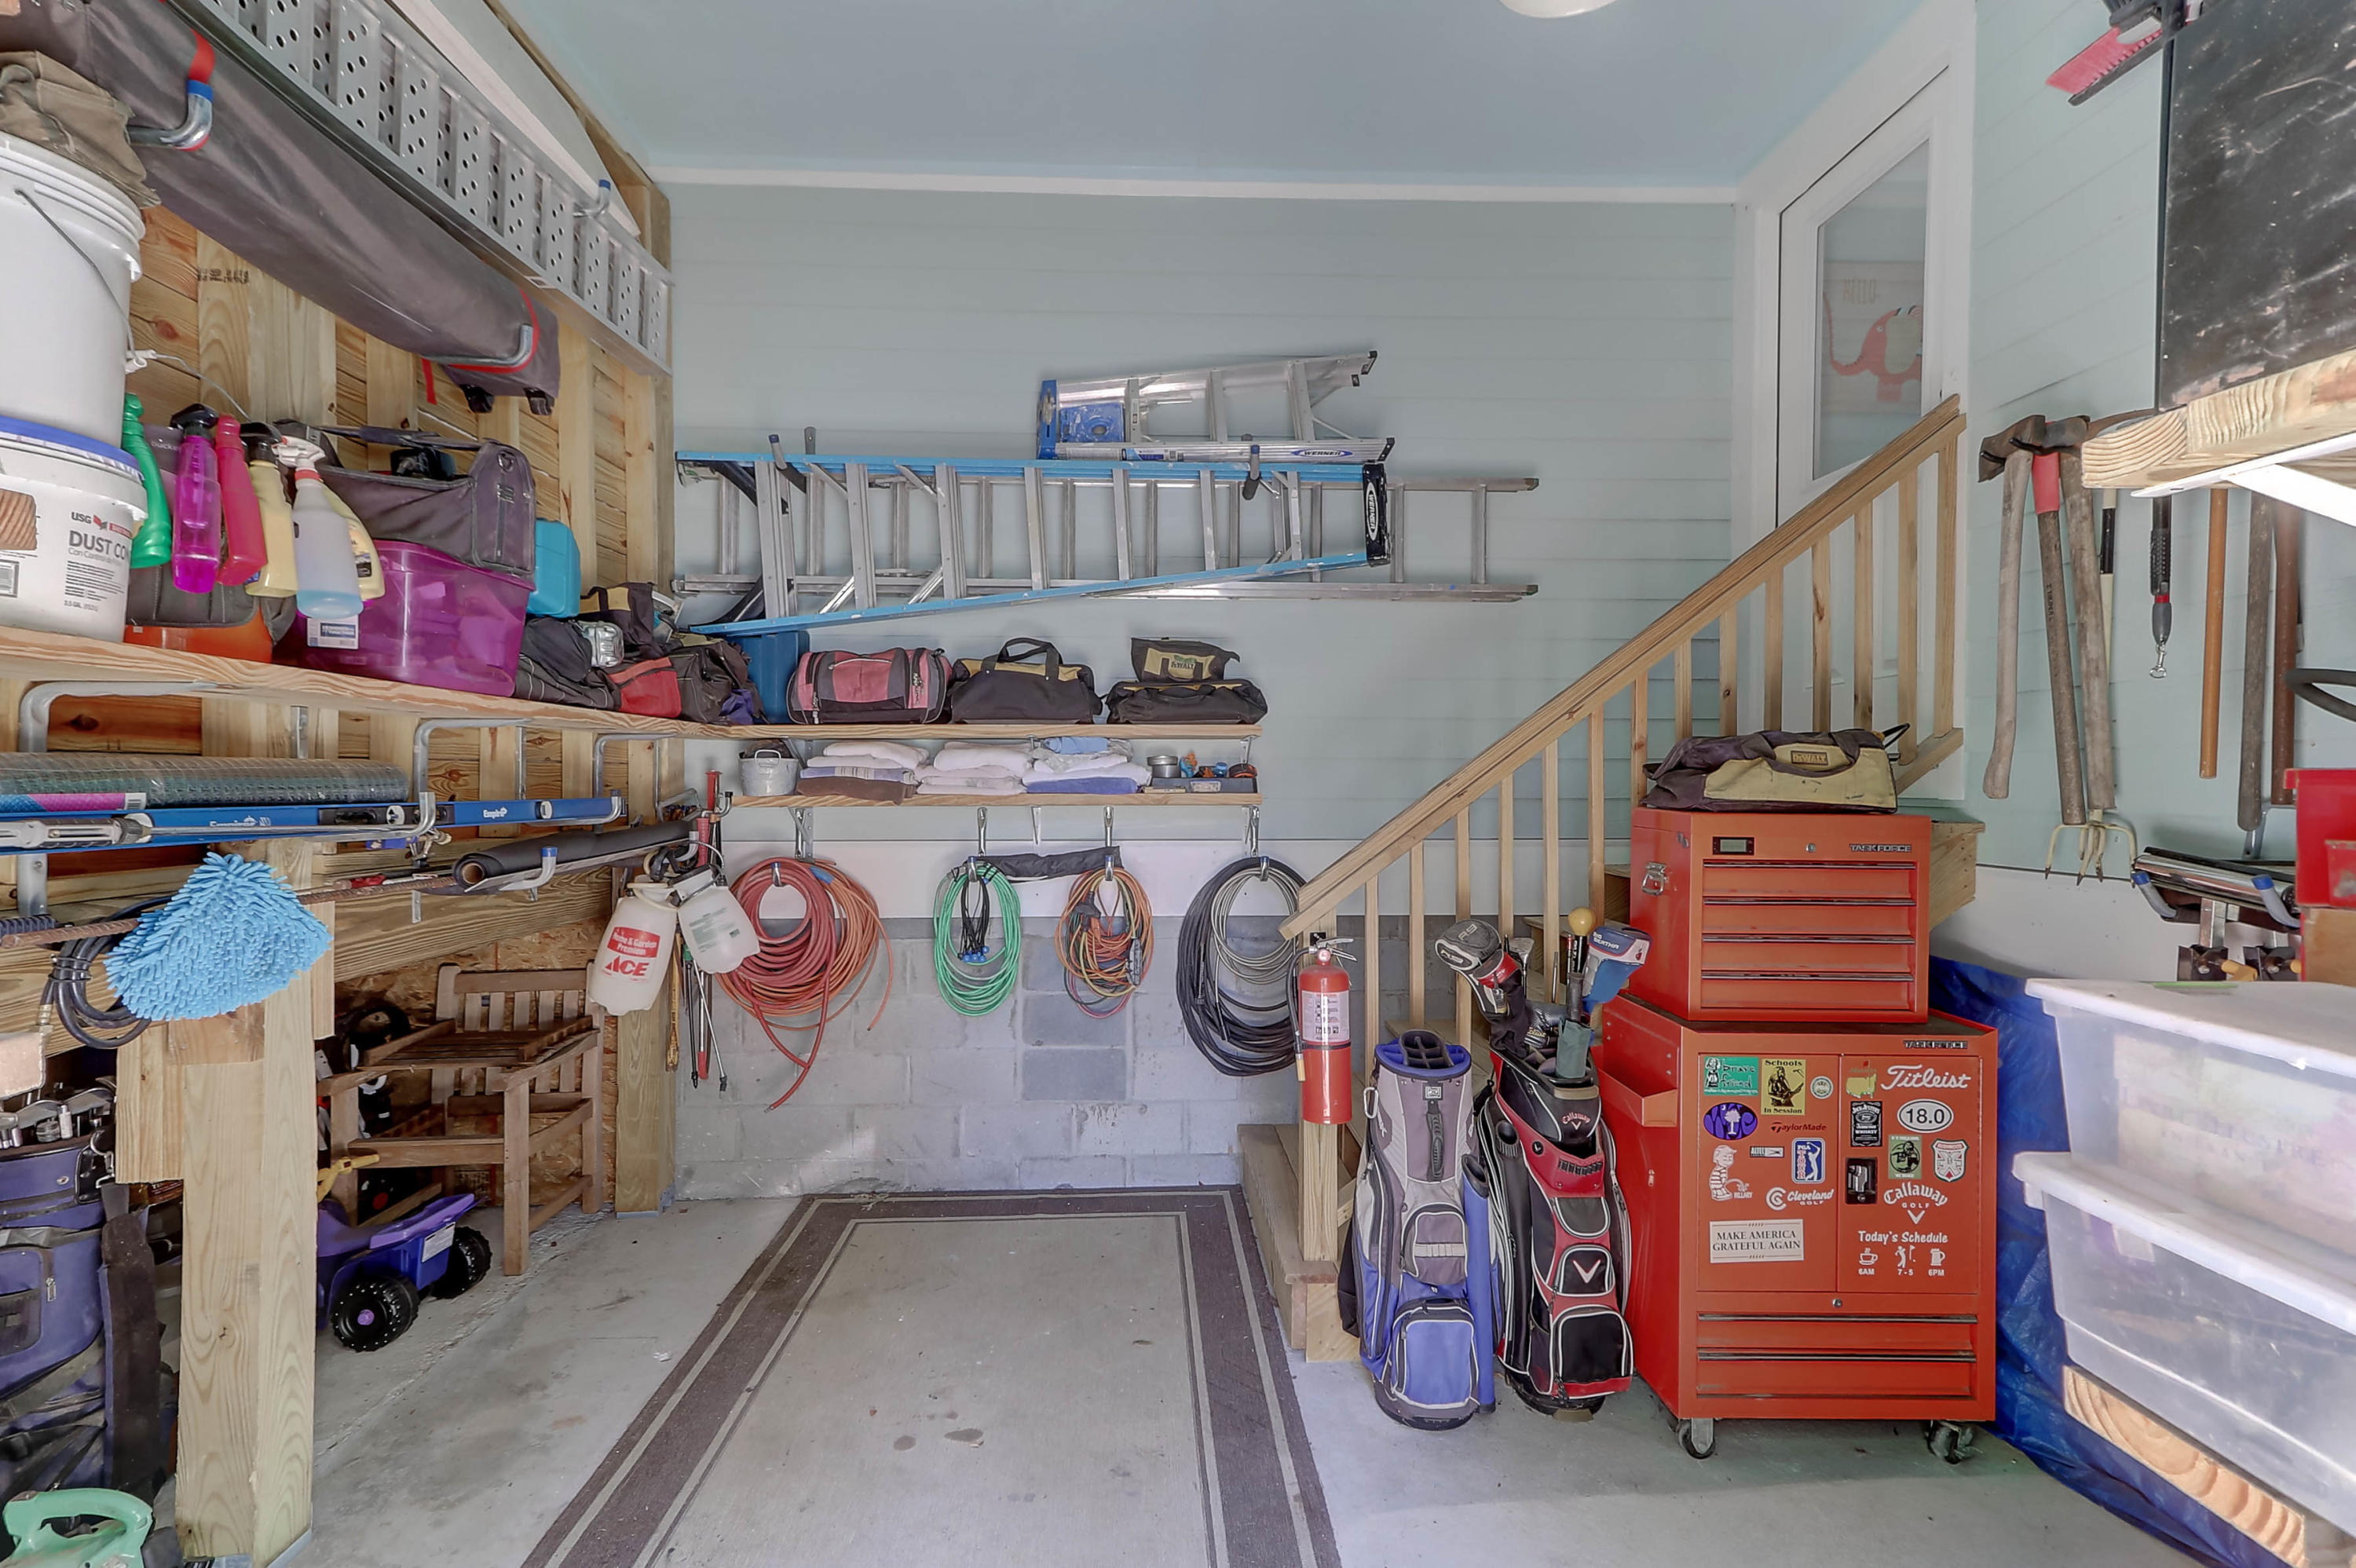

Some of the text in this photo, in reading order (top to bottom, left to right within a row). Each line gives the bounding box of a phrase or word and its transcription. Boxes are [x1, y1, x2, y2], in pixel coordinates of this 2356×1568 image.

[71, 512, 92, 524] USG
[69, 530, 112, 554] DUST
[616, 943, 646, 955] Premium
[634, 939, 657, 948] Garden
[1593, 938, 1619, 949] BERTHA
[605, 956, 649, 976] ACE
[1720, 1073, 1752, 1088] friend
[1880, 1064, 1972, 1091] Titleist
[1561, 1112, 1590, 1124] Callaway
[1906, 1109, 1945, 1124] 18.0
[1770, 1121, 1827, 1133] TaylorMade
[1797, 1150, 1806, 1179] TOUR
[1787, 1189, 1835, 1201] Cleveland
[1884, 1182, 1948, 1206] Callaway
[1717, 1230, 1796, 1240] MAKE AMERICA
[1858, 1230, 1948, 1245] Today's Schedule
[1713, 1240, 1801, 1251] GRATEFUL AGAIN
